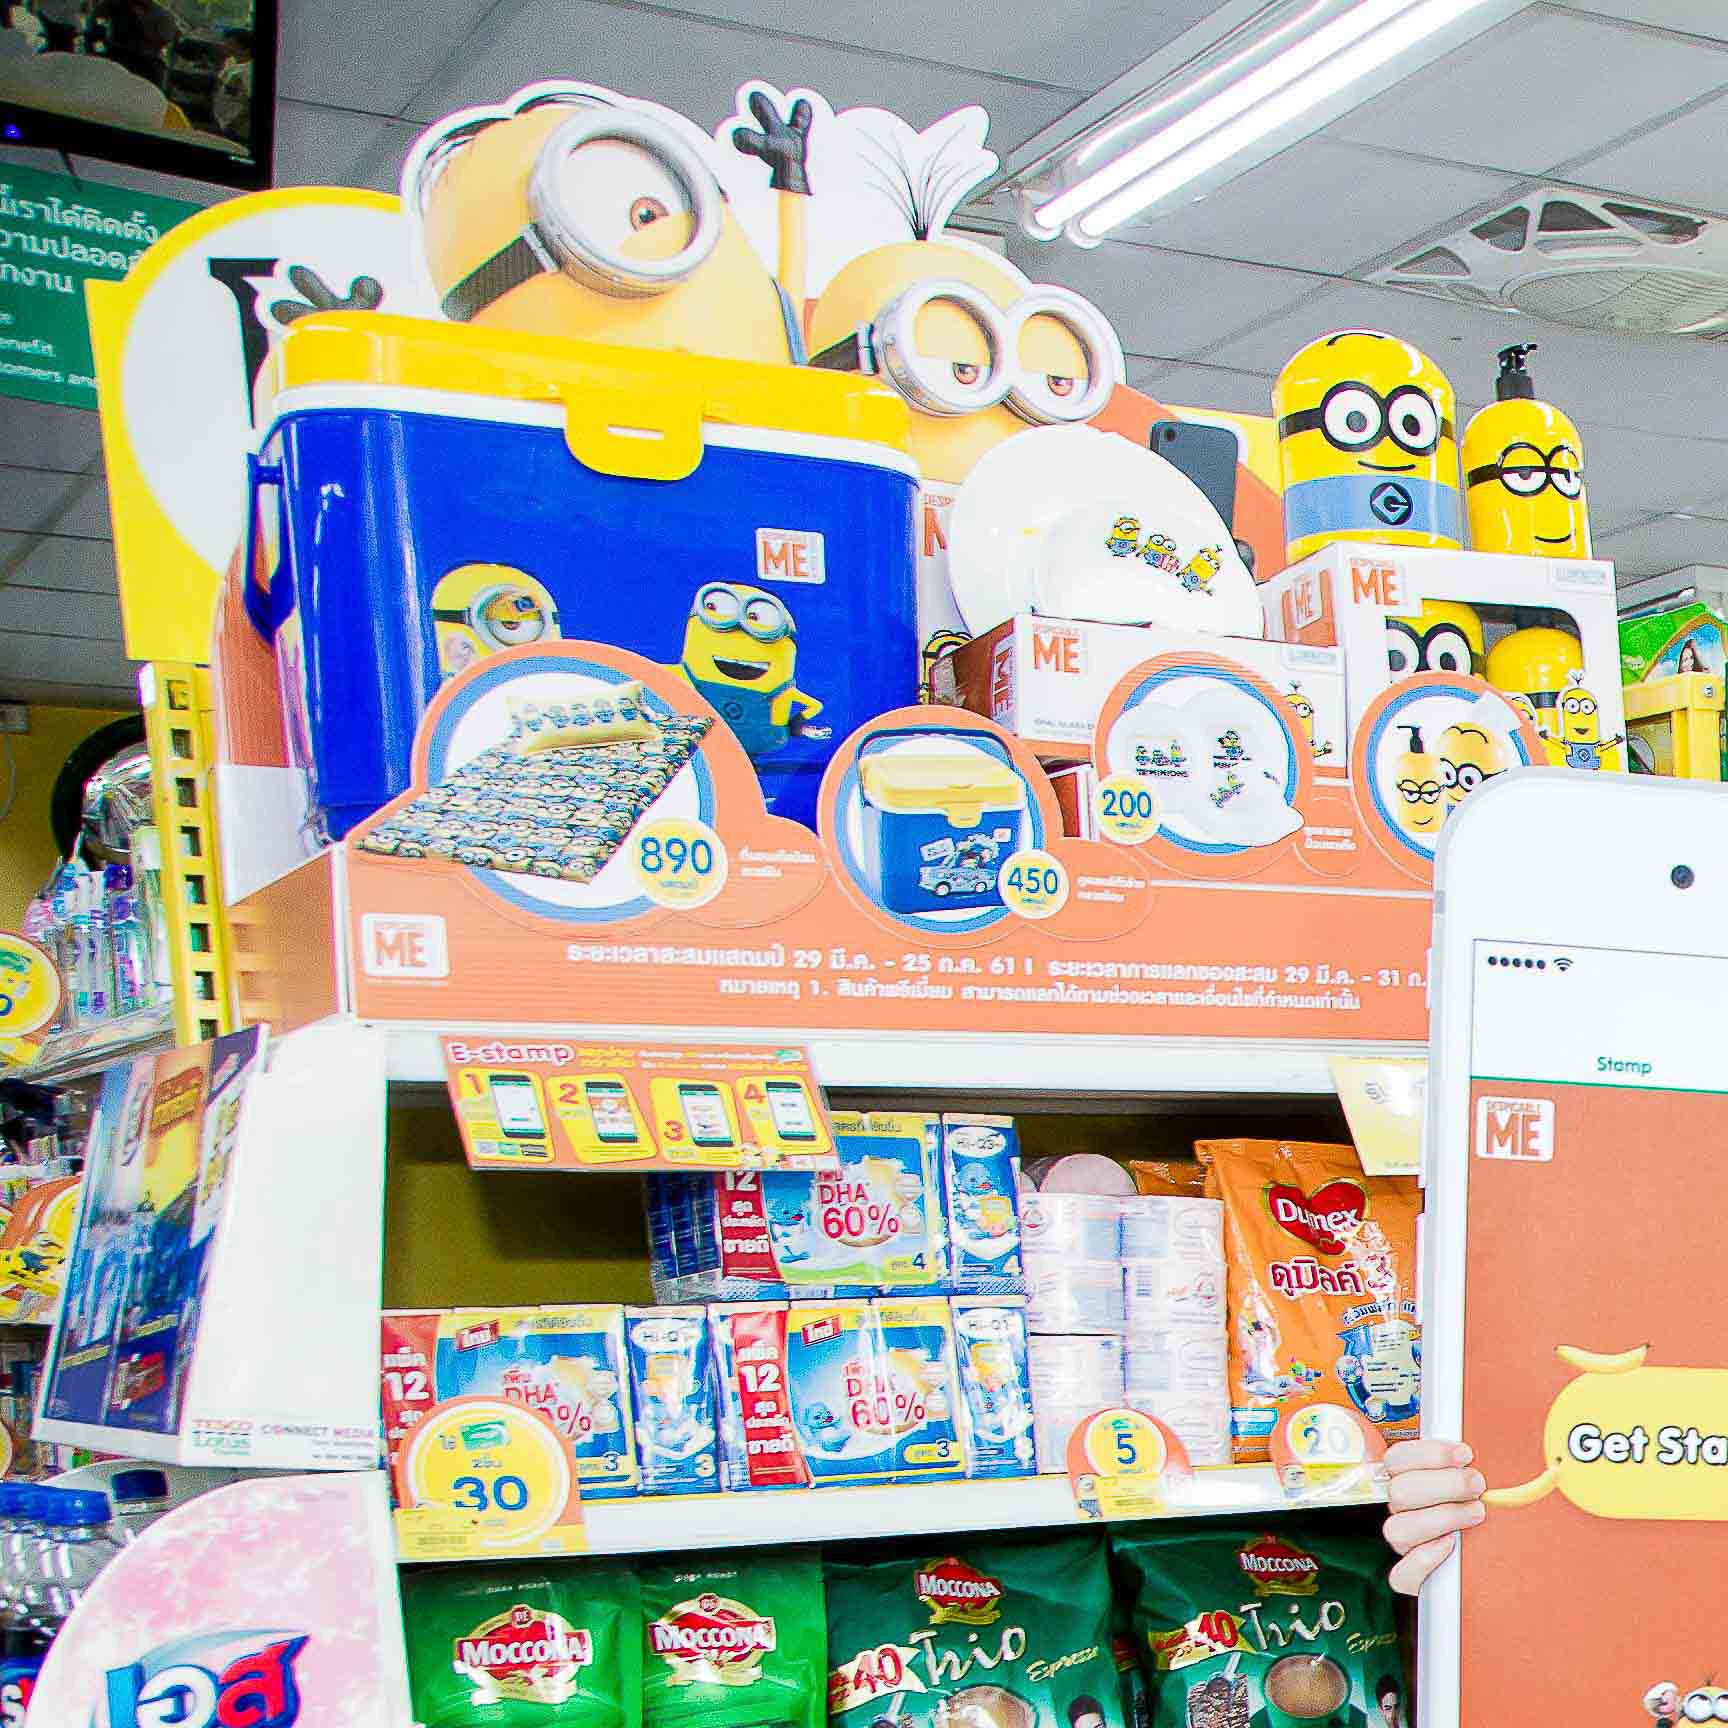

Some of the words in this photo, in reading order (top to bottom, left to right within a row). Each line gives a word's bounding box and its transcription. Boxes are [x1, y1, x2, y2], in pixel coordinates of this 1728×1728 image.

[763, 539, 809, 579] ME
[1352, 569, 1401, 606] ME
[1033, 634, 1081, 674] ME
[1103, 788, 1152, 820] 200
[640, 836, 713, 876] 890
[1007, 867, 1059, 896] 450
[374, 929, 427, 969] ME
[794, 950, 821, 969] 29
[902, 953, 931, 973] 25
[990, 957, 1015, 976] 61
[1284, 965, 1308, 985] 29
[1378, 968, 1401, 988] 31
[1596, 1055, 1653, 1078] Stamp
[1486, 1114, 1543, 1158] ME
[819, 1184, 869, 1204] DHA
[822, 1203, 901, 1239] 60%
[1276, 1196, 1363, 1233] Dumex
[384, 1371, 430, 1401] 12
[738, 1365, 783, 1392] 12
[1115, 1433, 1137, 1466] 5
[1568, 1423, 1649, 1468] Get
[452, 1475, 528, 1511] 30
[1240, 1552, 1319, 1574] MOCCONA
[918, 1573, 1001, 1599] MOCCONA
[655, 1622, 773, 1652] MOCCONA
[1240, 1600, 1347, 1651] Trio
[462, 1635, 588, 1667] MOCCONA
[909, 1626, 1028, 1686] Trio
[853, 1647, 905, 1693] 40
